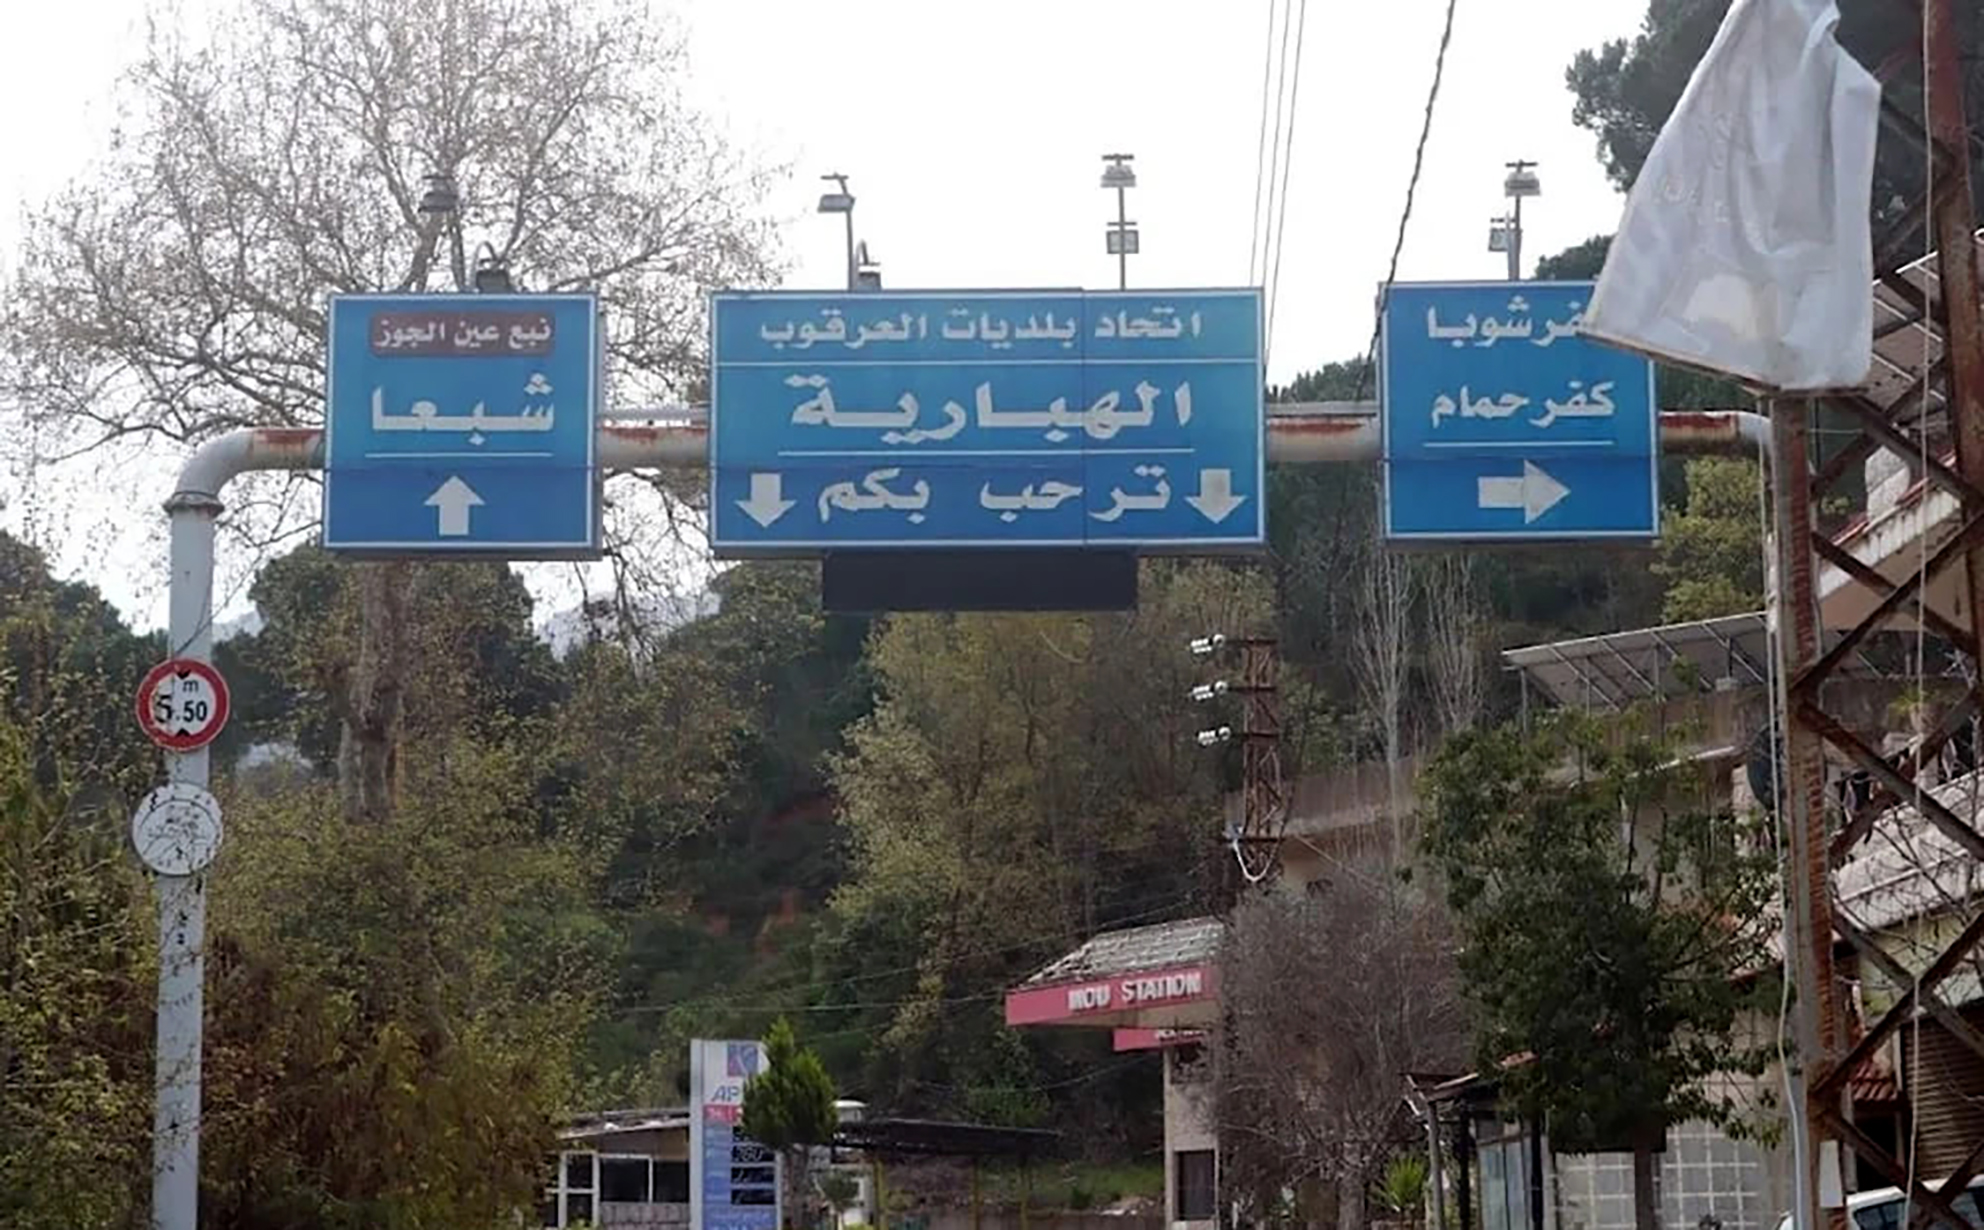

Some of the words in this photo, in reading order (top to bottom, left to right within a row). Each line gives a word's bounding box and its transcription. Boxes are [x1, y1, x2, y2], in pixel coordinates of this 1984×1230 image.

[373, 319, 446, 348] الجوز
[454, 320, 500, 348] عين
[508, 316, 551, 349] نبع
[760, 309, 926, 349] العرقوب
[941, 306, 1077, 349] بلديات
[1095, 305, 1201, 339] اتحاد
[372, 372, 555, 446] شبعا
[785, 374, 1192, 445] الهبارية
[817, 467, 930, 524] بكم
[155, 695, 207, 723] 5.50
[1121, 972, 1202, 1002] STATION
